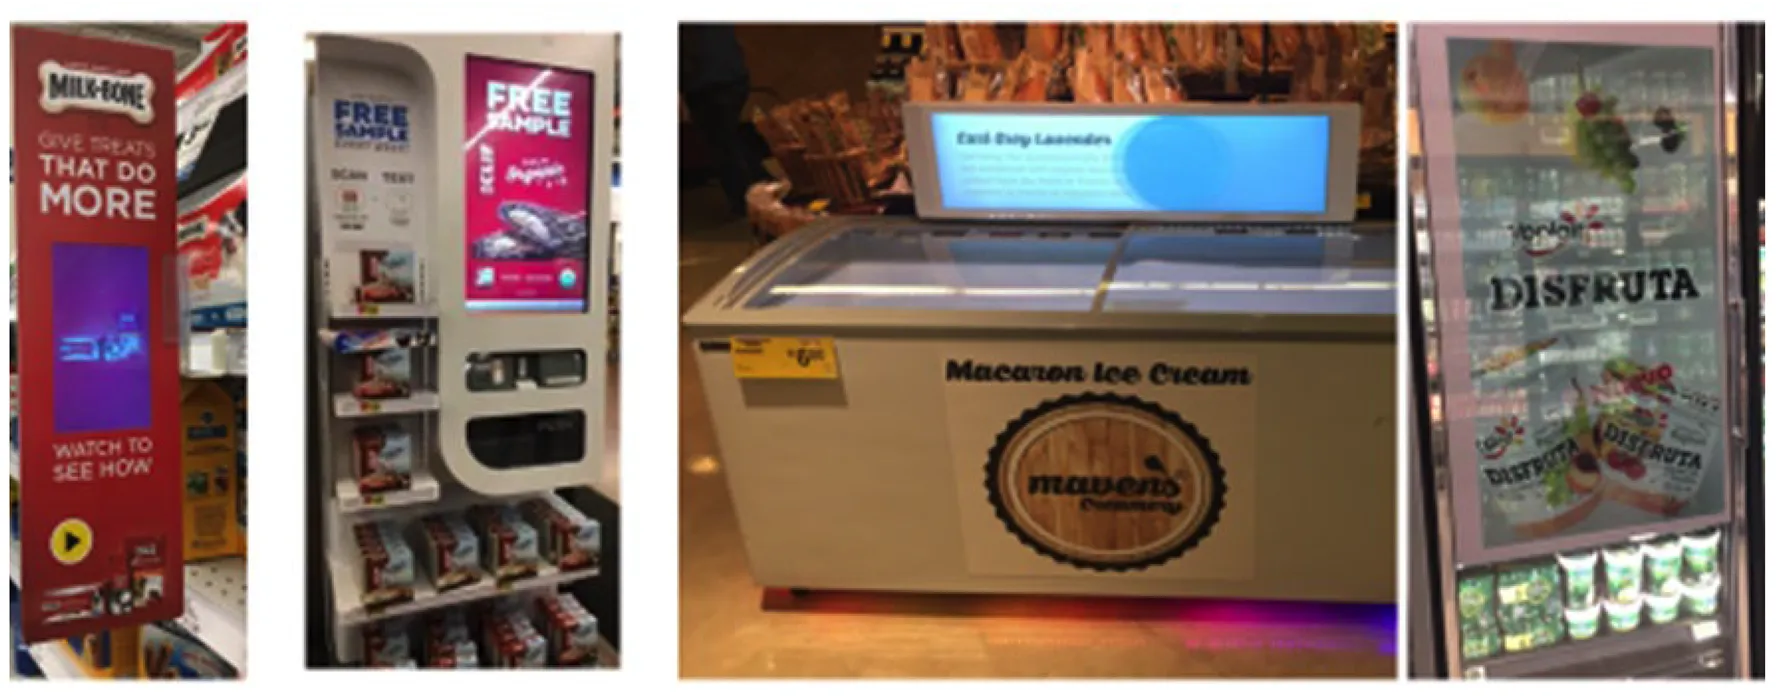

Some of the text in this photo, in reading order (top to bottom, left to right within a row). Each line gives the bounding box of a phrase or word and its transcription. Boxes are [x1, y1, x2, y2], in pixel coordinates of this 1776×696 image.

[49, 73, 145, 110] MILK-BONE
[487, 80, 572, 117] FREE
[333, 99, 409, 126] FREE
[487, 112, 571, 137] SAMPLE
[38, 130, 156, 159] GIVE TREATS
[334, 122, 409, 142] SAMPLE
[39, 154, 157, 183] THAT DO
[39, 183, 157, 220] MORE
[1490, 268, 1700, 311] DISFRUTA
[946, 360, 1252, 386] Macaron Ice Cream
[53, 437, 153, 459] WATCH TO
[1604, 422, 1702, 470] DISFRUTA
[53, 459, 153, 482] SEE HOW
[1484, 437, 1580, 487] DISFRUTA
